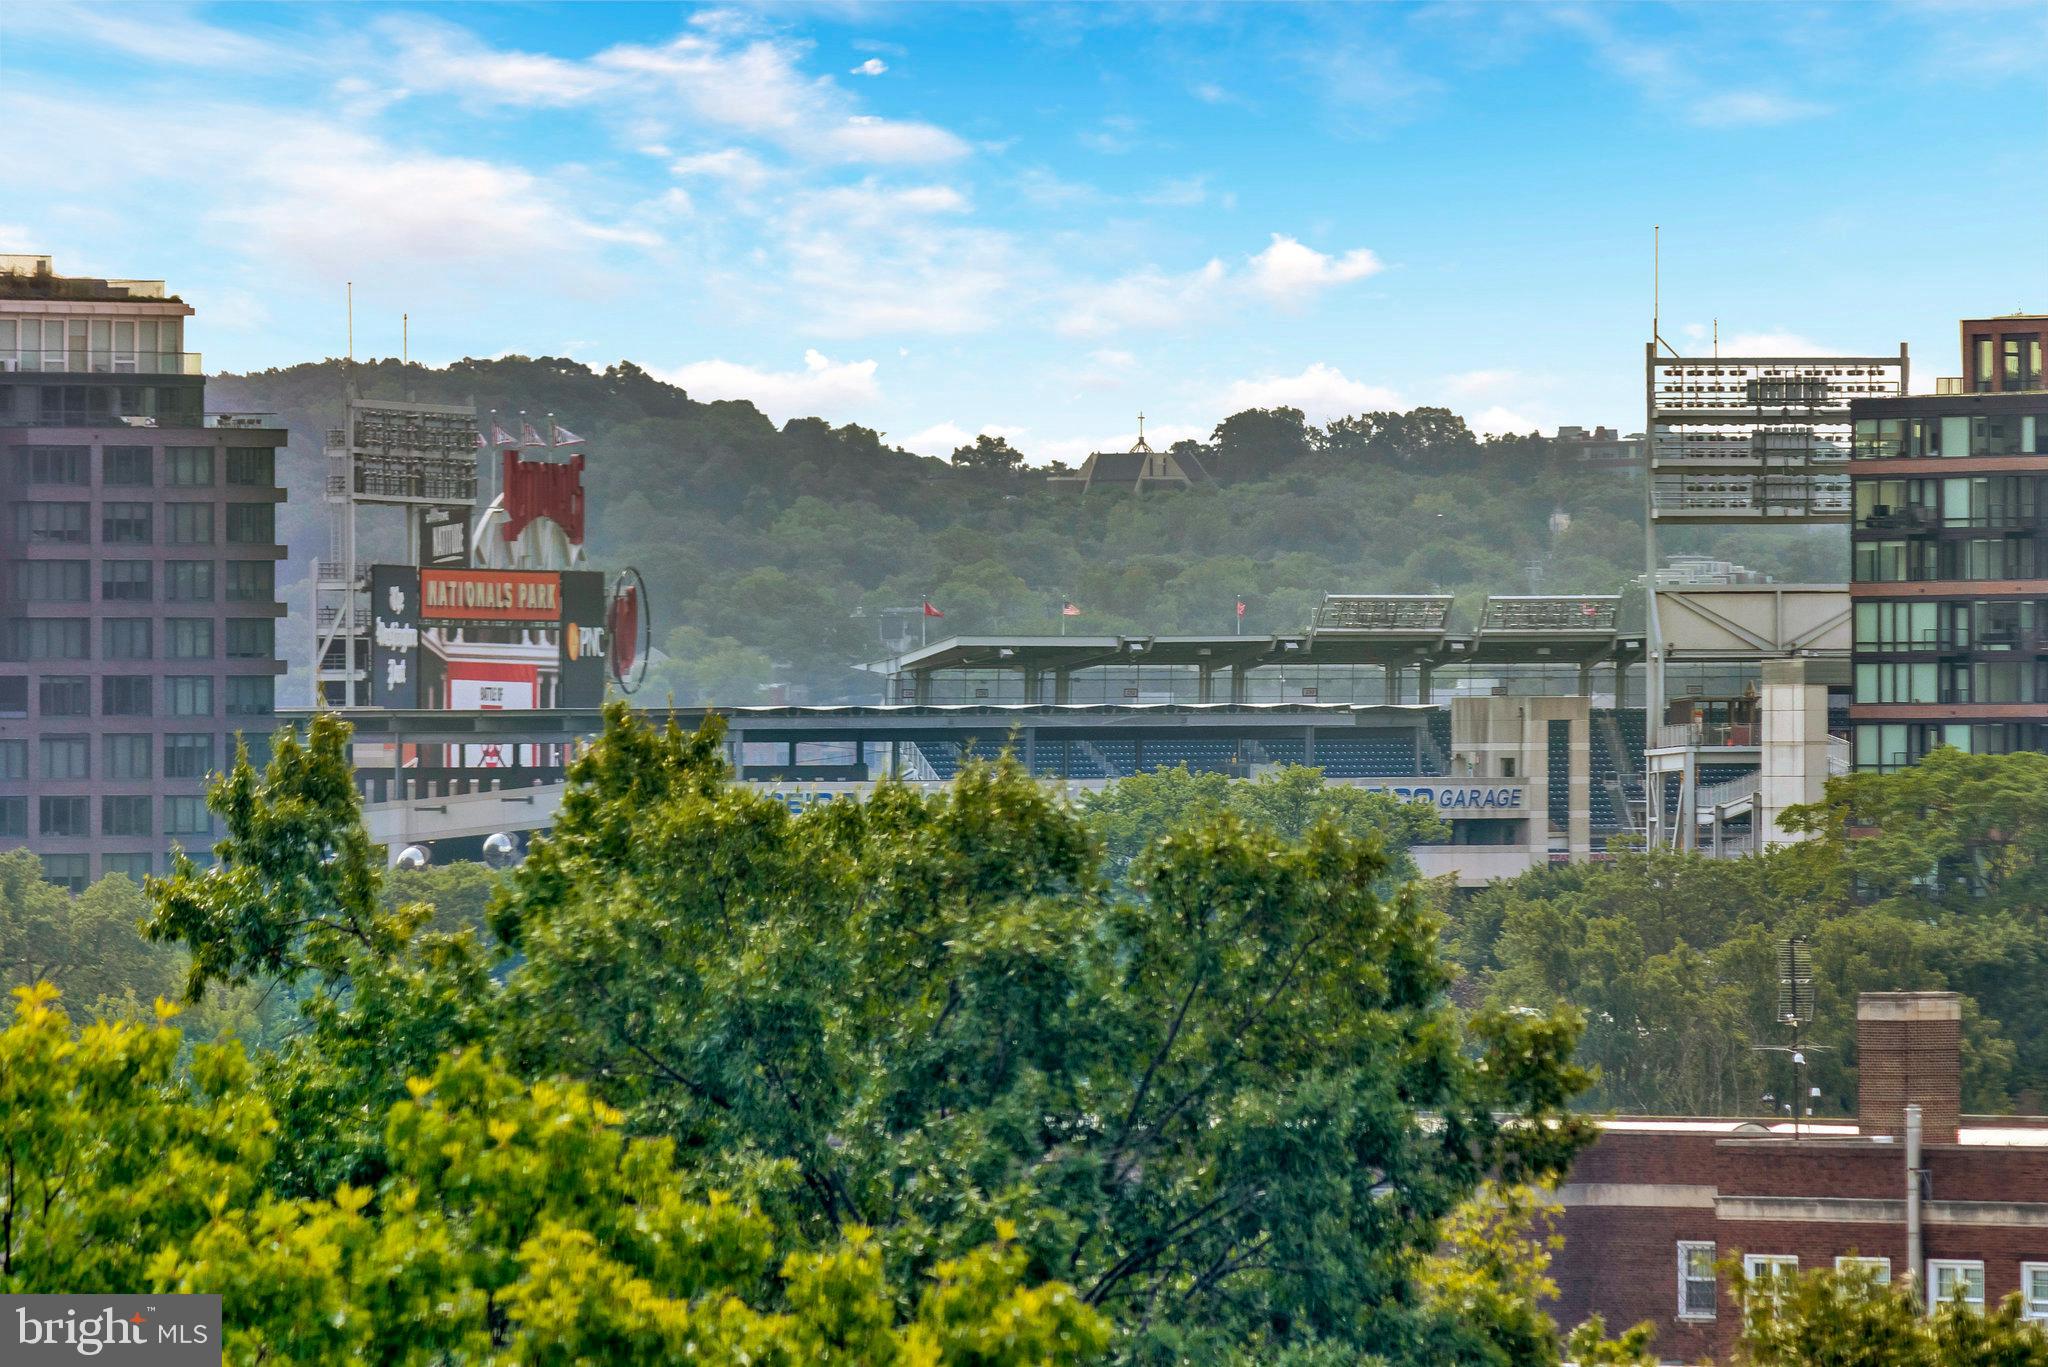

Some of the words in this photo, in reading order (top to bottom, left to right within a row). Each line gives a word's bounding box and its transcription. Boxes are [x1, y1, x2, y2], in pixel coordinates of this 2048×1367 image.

[427, 580, 513, 608] NATIONALS
[517, 583, 556, 609] PARK
[579, 627, 605, 656] PNC
[1440, 789, 1523, 808] GARAGE
